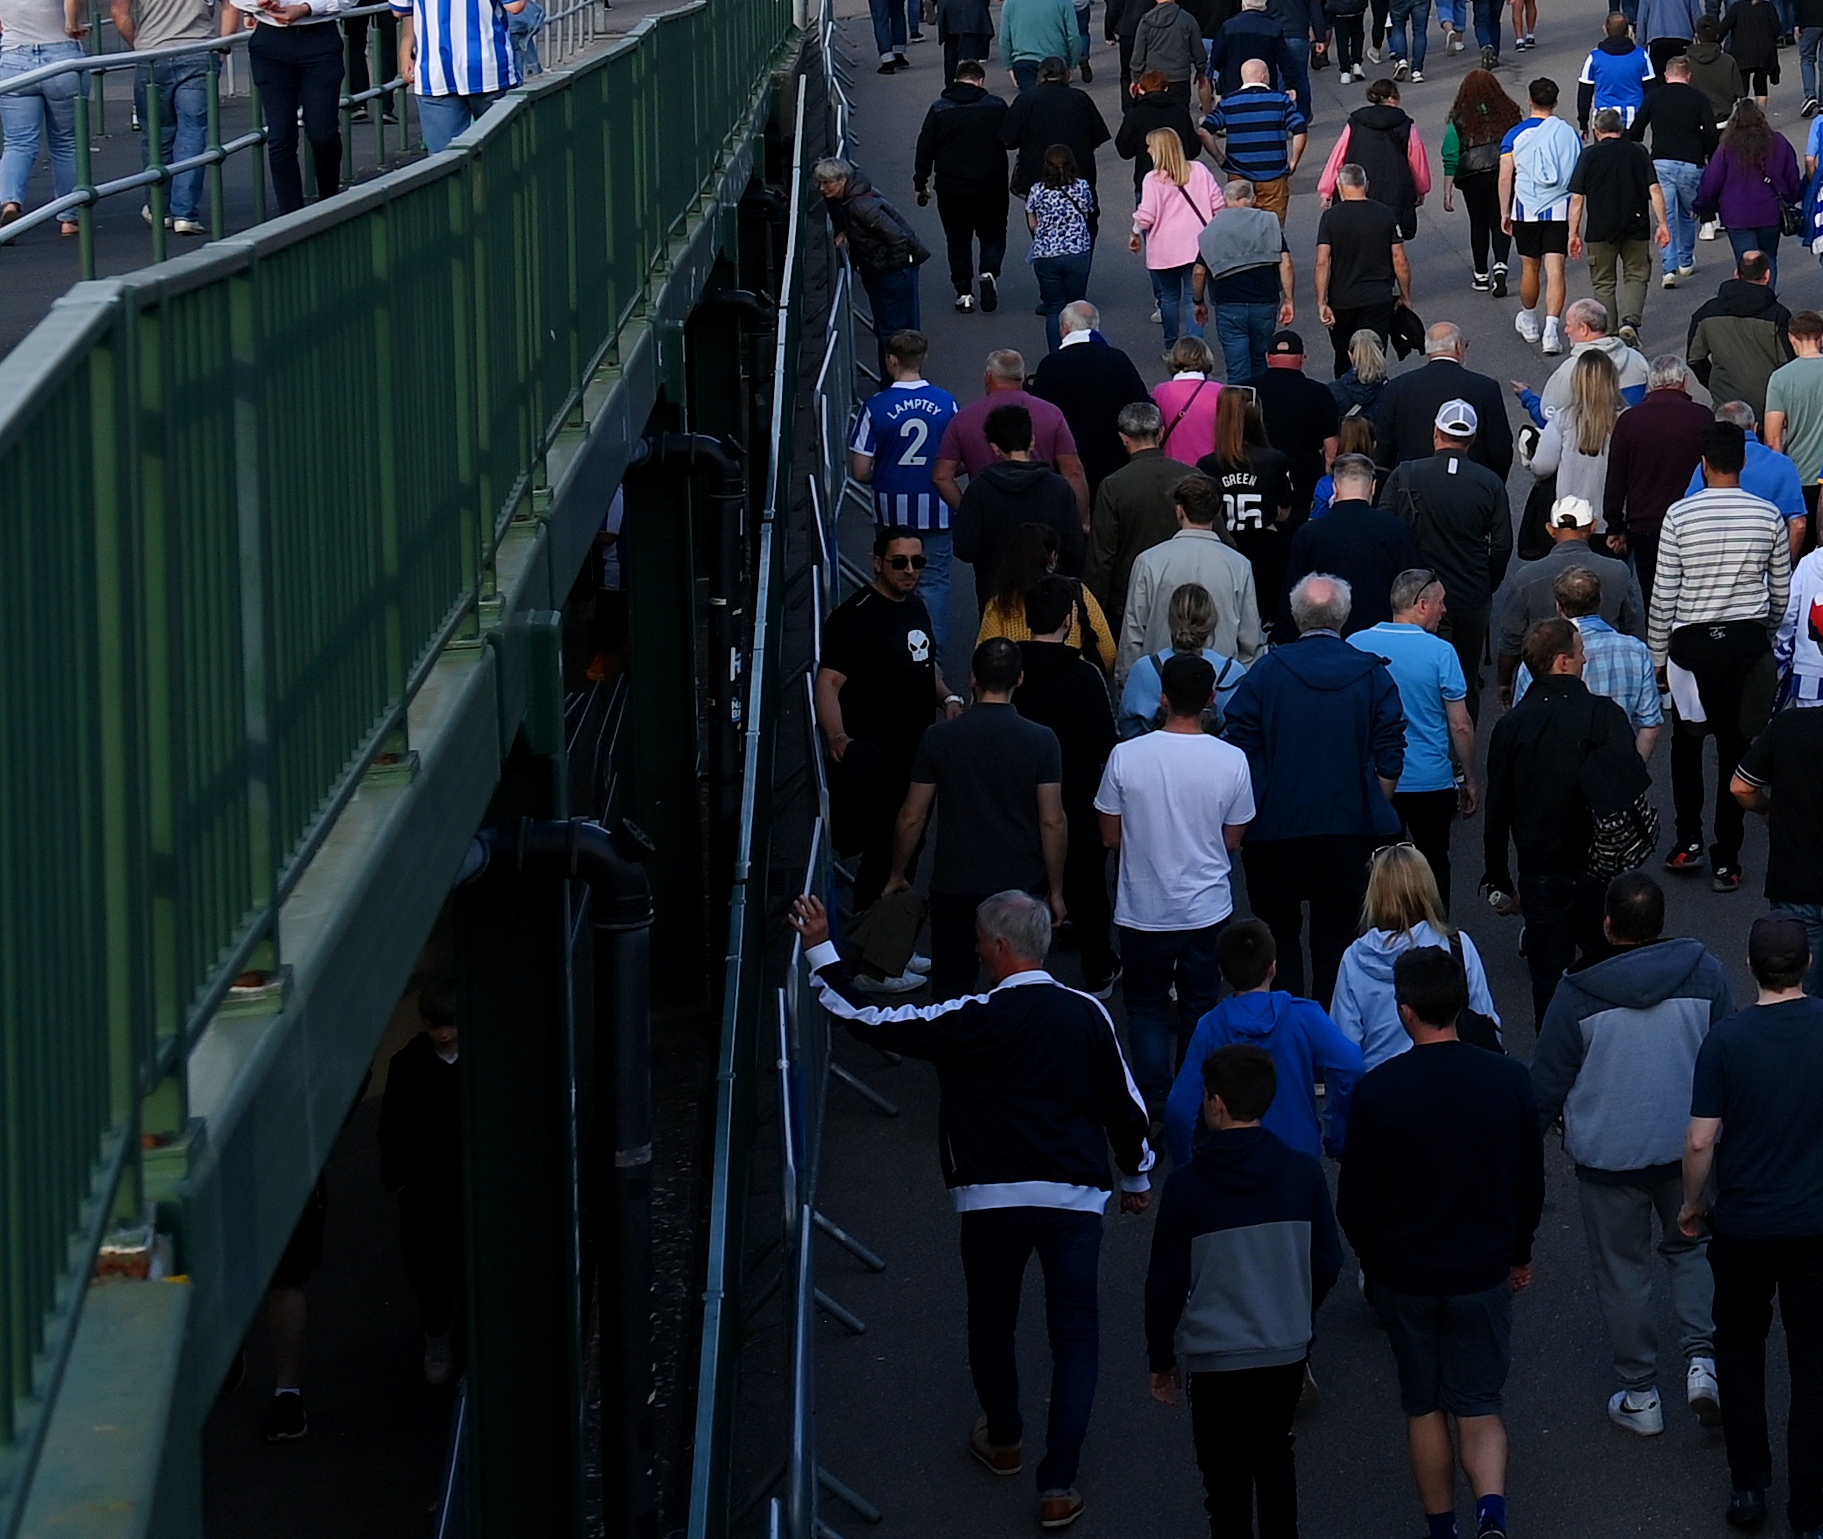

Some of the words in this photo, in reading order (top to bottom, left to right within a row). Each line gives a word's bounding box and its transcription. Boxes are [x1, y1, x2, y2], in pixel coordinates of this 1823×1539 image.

[886, 398, 942, 420] LAMPTEY
[897, 418, 928, 466] 2
[1221, 472, 1258, 488] GREEN
[1222, 493, 1263, 532] 15
